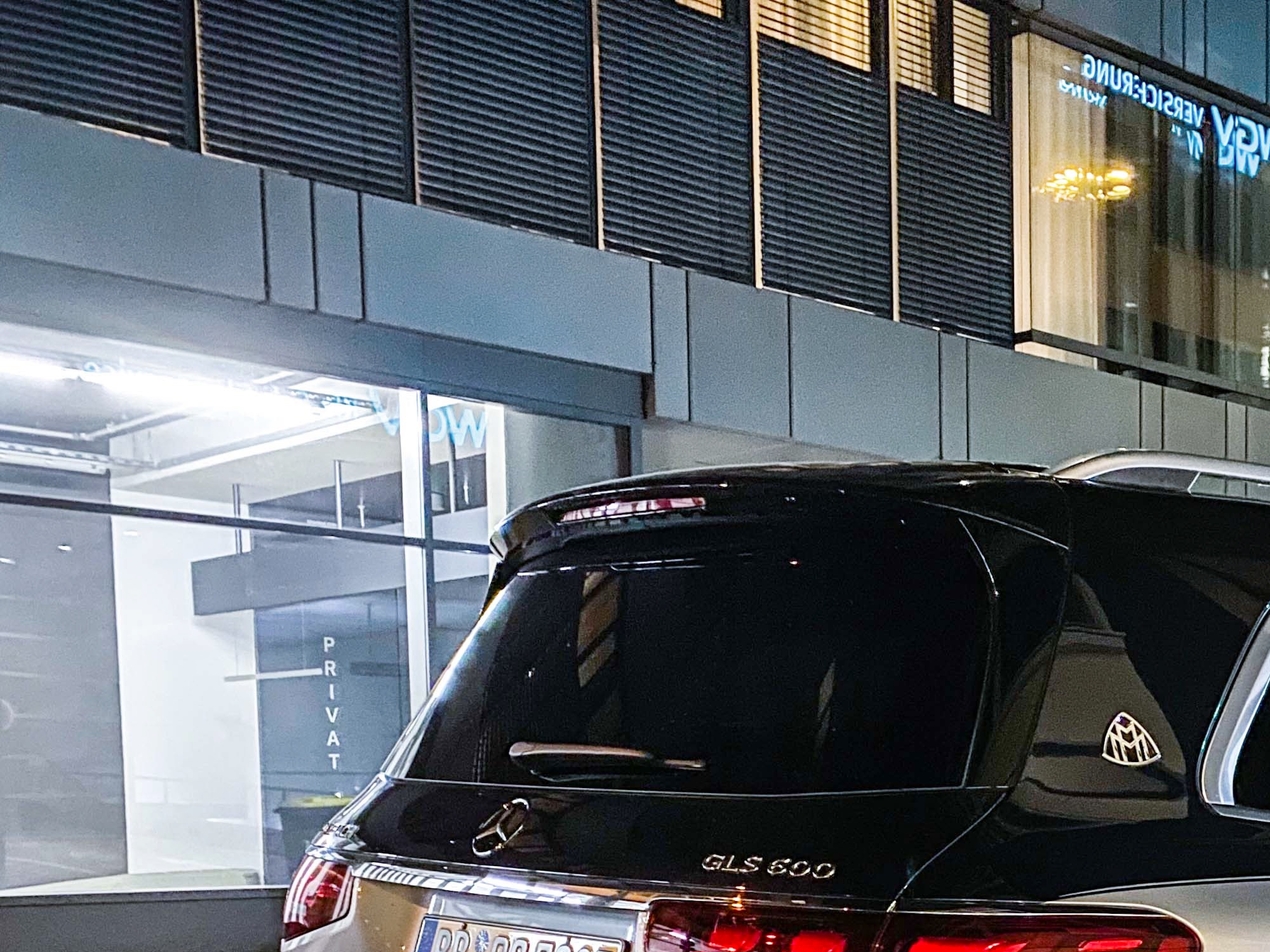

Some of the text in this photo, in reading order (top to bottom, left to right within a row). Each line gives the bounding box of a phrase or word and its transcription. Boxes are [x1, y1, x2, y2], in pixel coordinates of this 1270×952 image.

[323, 636, 340, 770] PRIVAT
[701, 853, 836, 879] GLS 600
